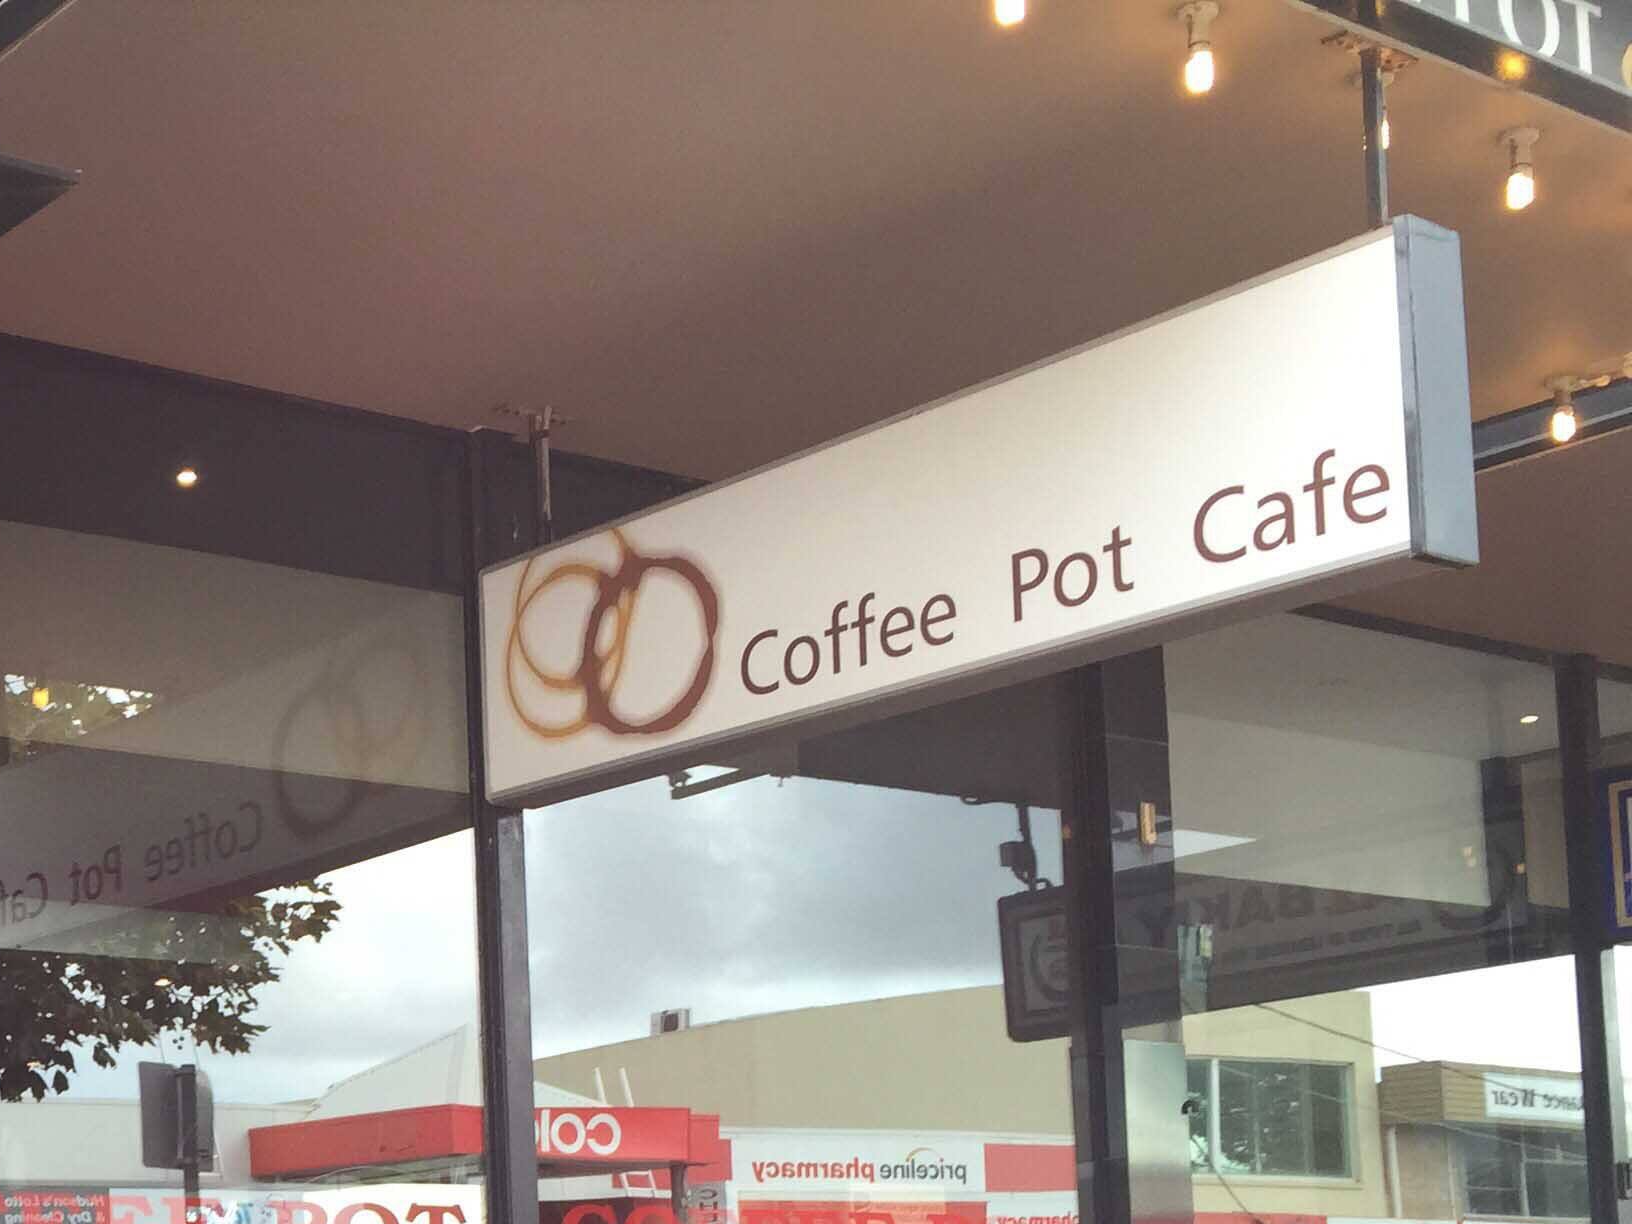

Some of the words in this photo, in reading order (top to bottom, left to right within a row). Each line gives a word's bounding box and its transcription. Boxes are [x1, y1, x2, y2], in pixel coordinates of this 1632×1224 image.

[1454, 0, 1602, 75] OT
[739, 591, 959, 697] Coffee
[1011, 525, 1136, 624] Pot
[1193, 449, 1392, 564] Cafe
